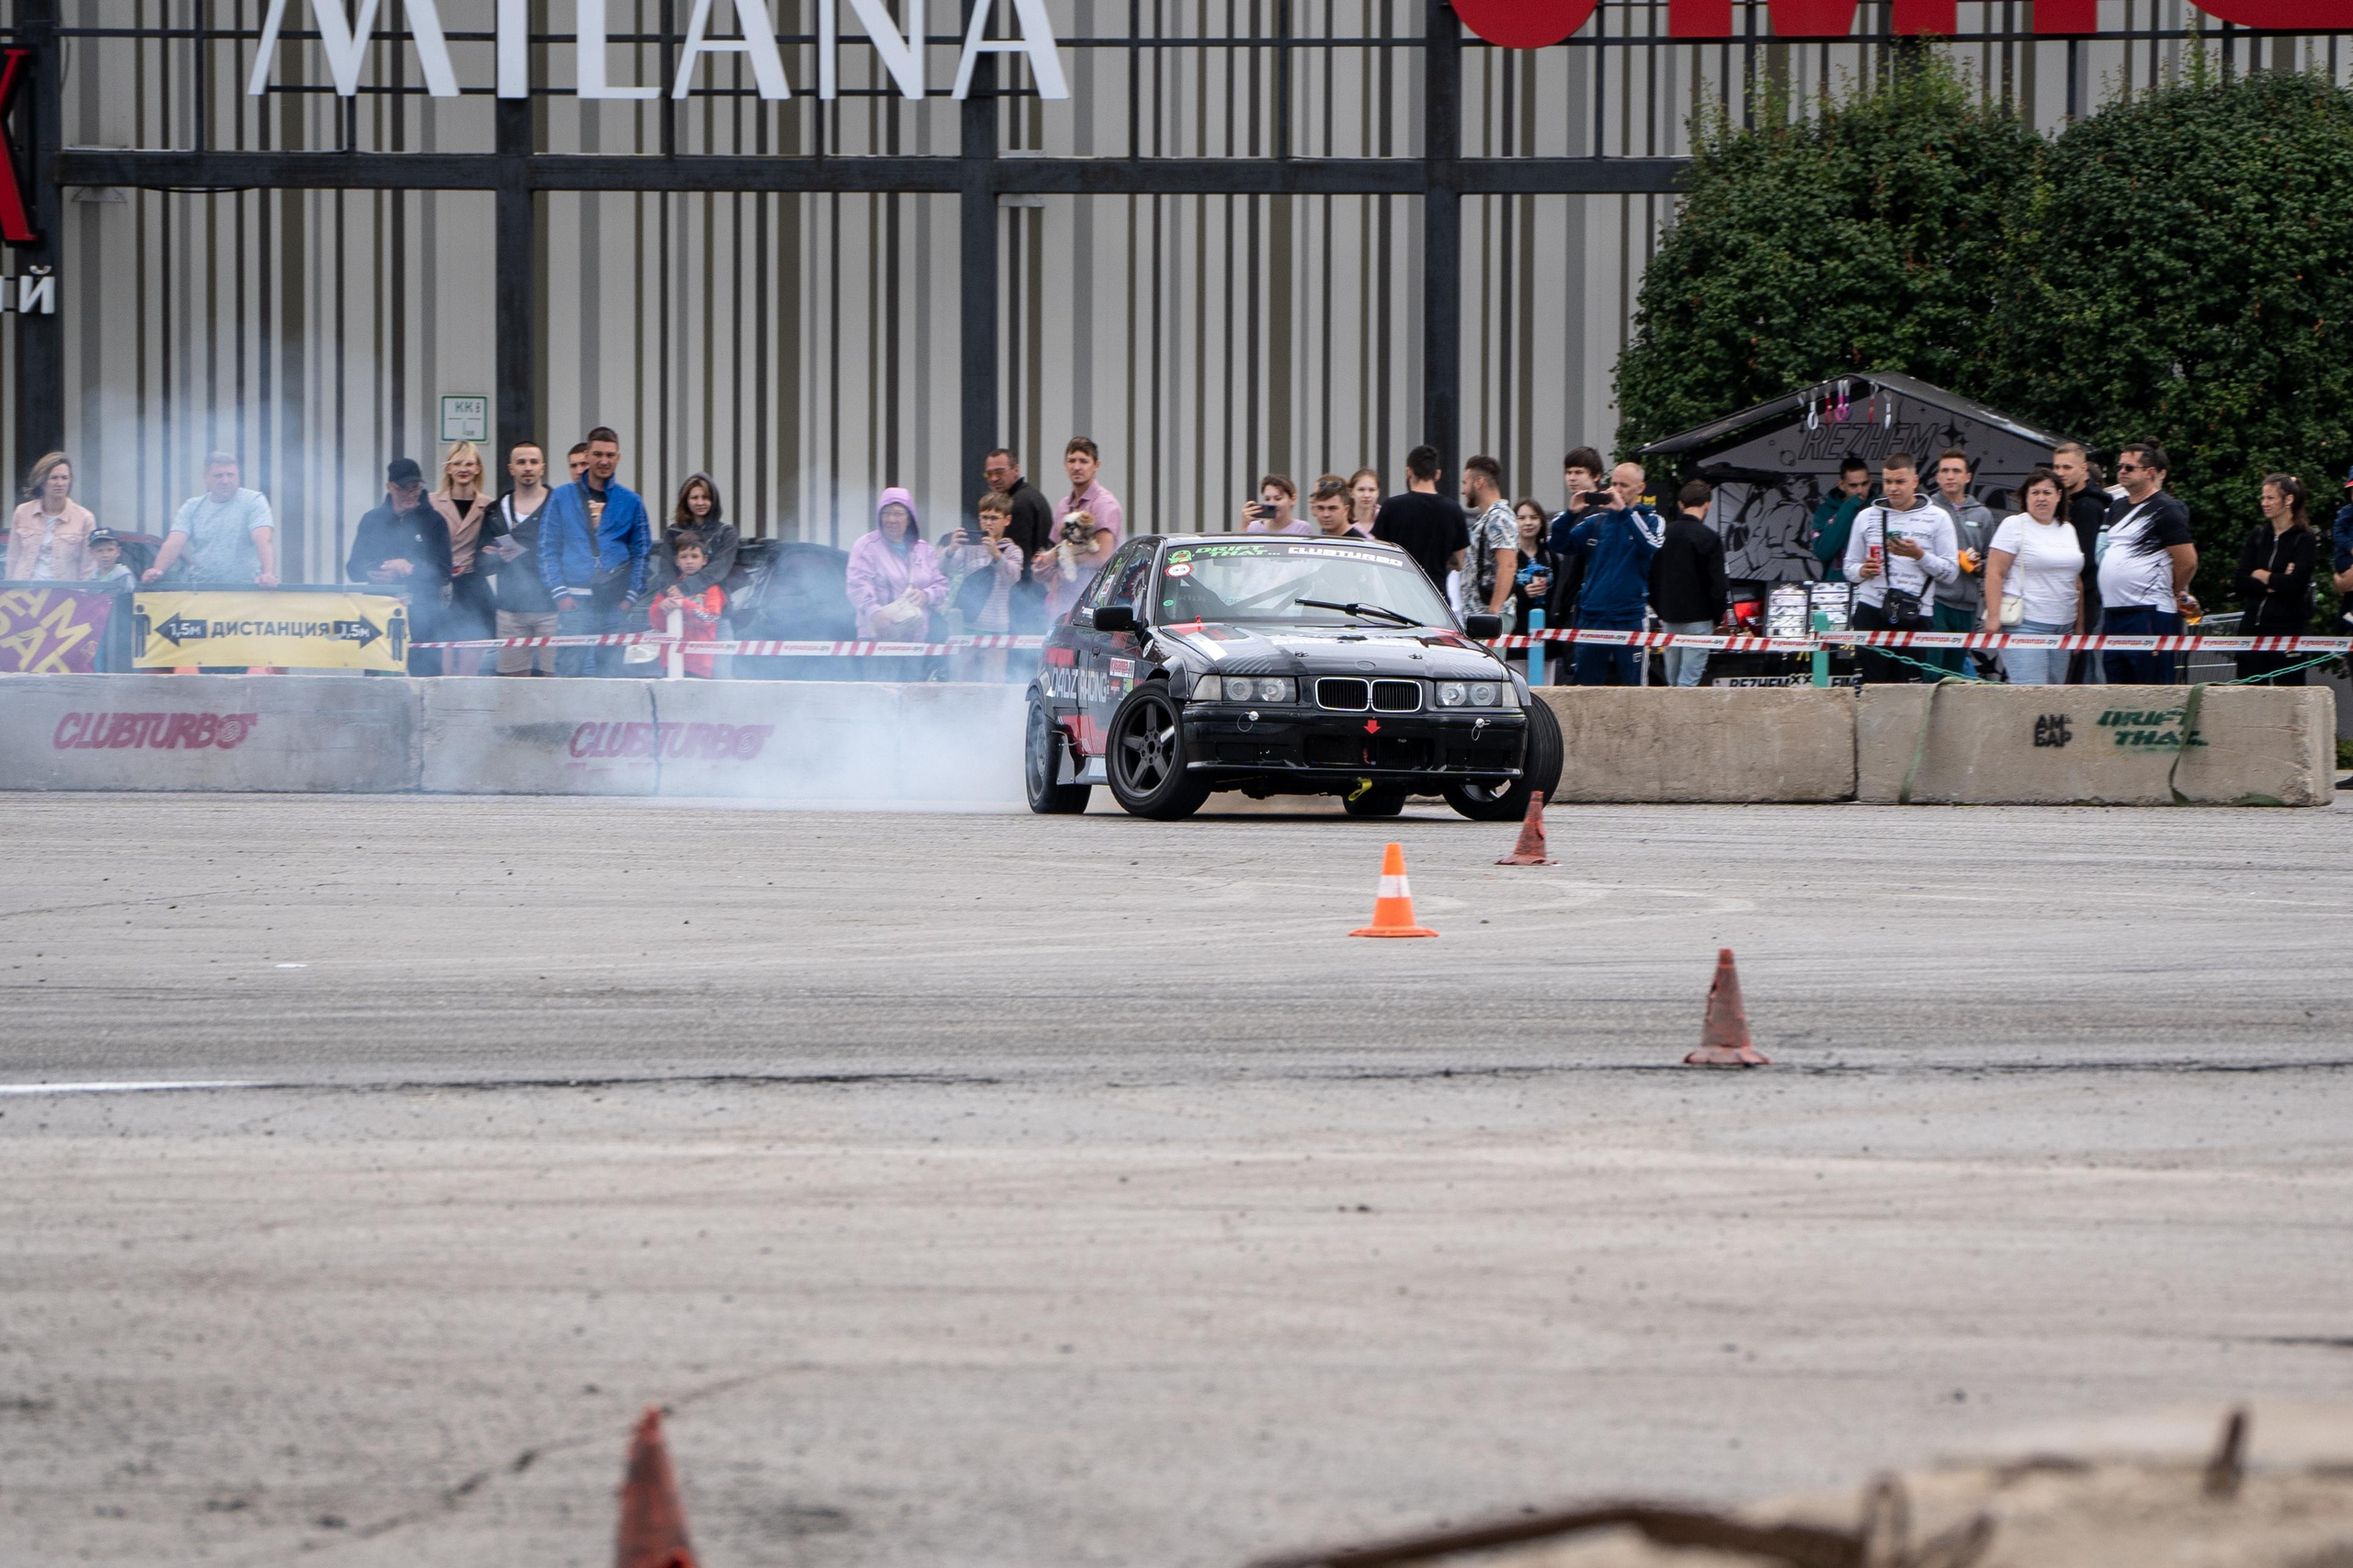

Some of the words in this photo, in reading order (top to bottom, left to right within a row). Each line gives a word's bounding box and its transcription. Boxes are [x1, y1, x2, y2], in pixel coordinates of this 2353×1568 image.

[1195, 545, 1265, 554] DRIFT
[1288, 547, 1404, 568] CLUBTURBO
[210, 620, 330, 639] ДИСТАНЦИЯ
[53, 711, 258, 750] CLUBTURBO
[569, 722, 775, 761] CLUBTURBO
